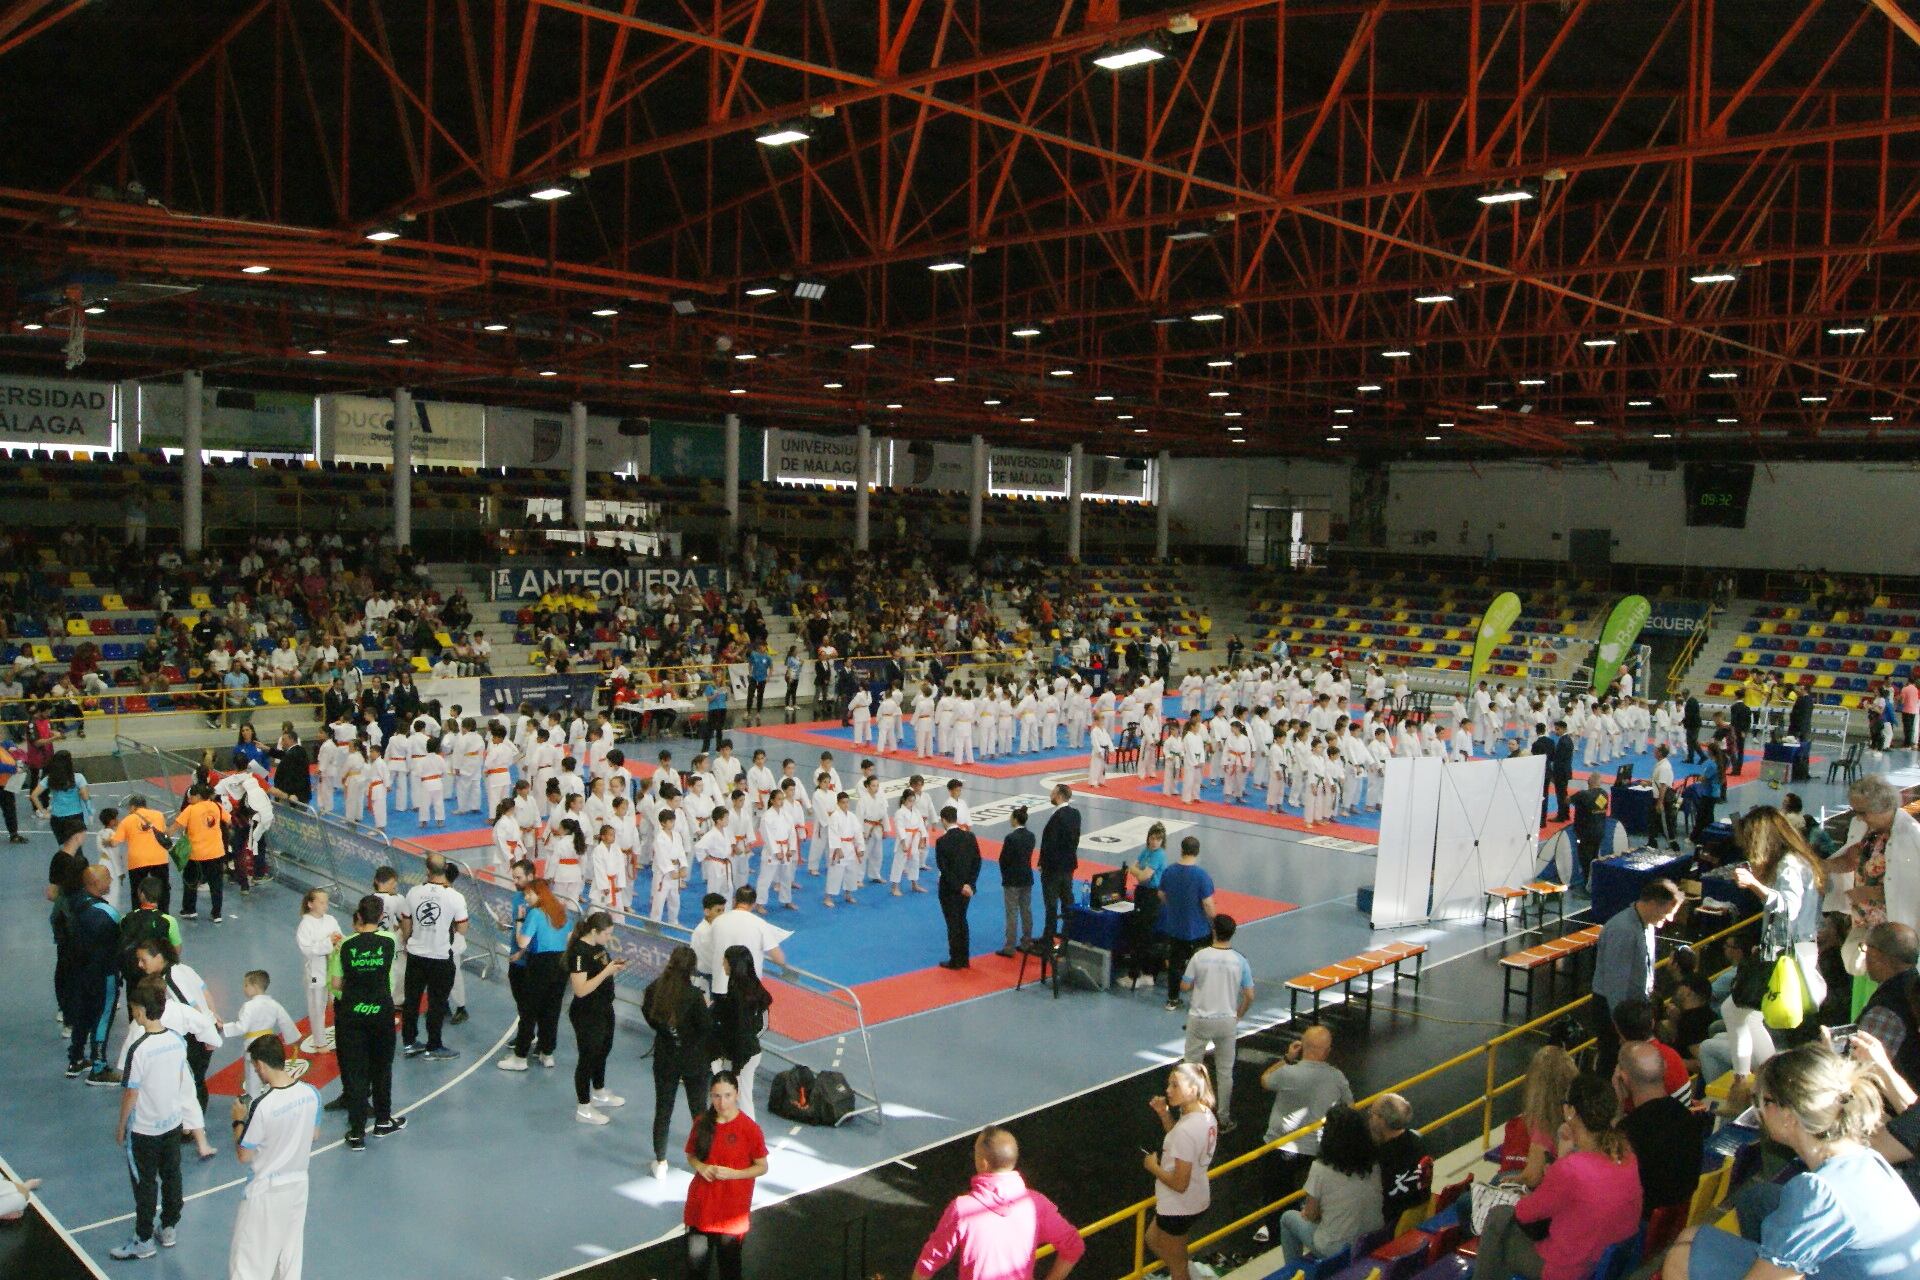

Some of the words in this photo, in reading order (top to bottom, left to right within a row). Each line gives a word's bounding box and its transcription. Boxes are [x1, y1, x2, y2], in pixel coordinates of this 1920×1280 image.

[781, 457, 799, 471] DE
[992, 454, 1063, 470] UNIVERSIDAD
[992, 471, 1006, 483] DE
[518, 569, 698, 597] ANTEQUERA
